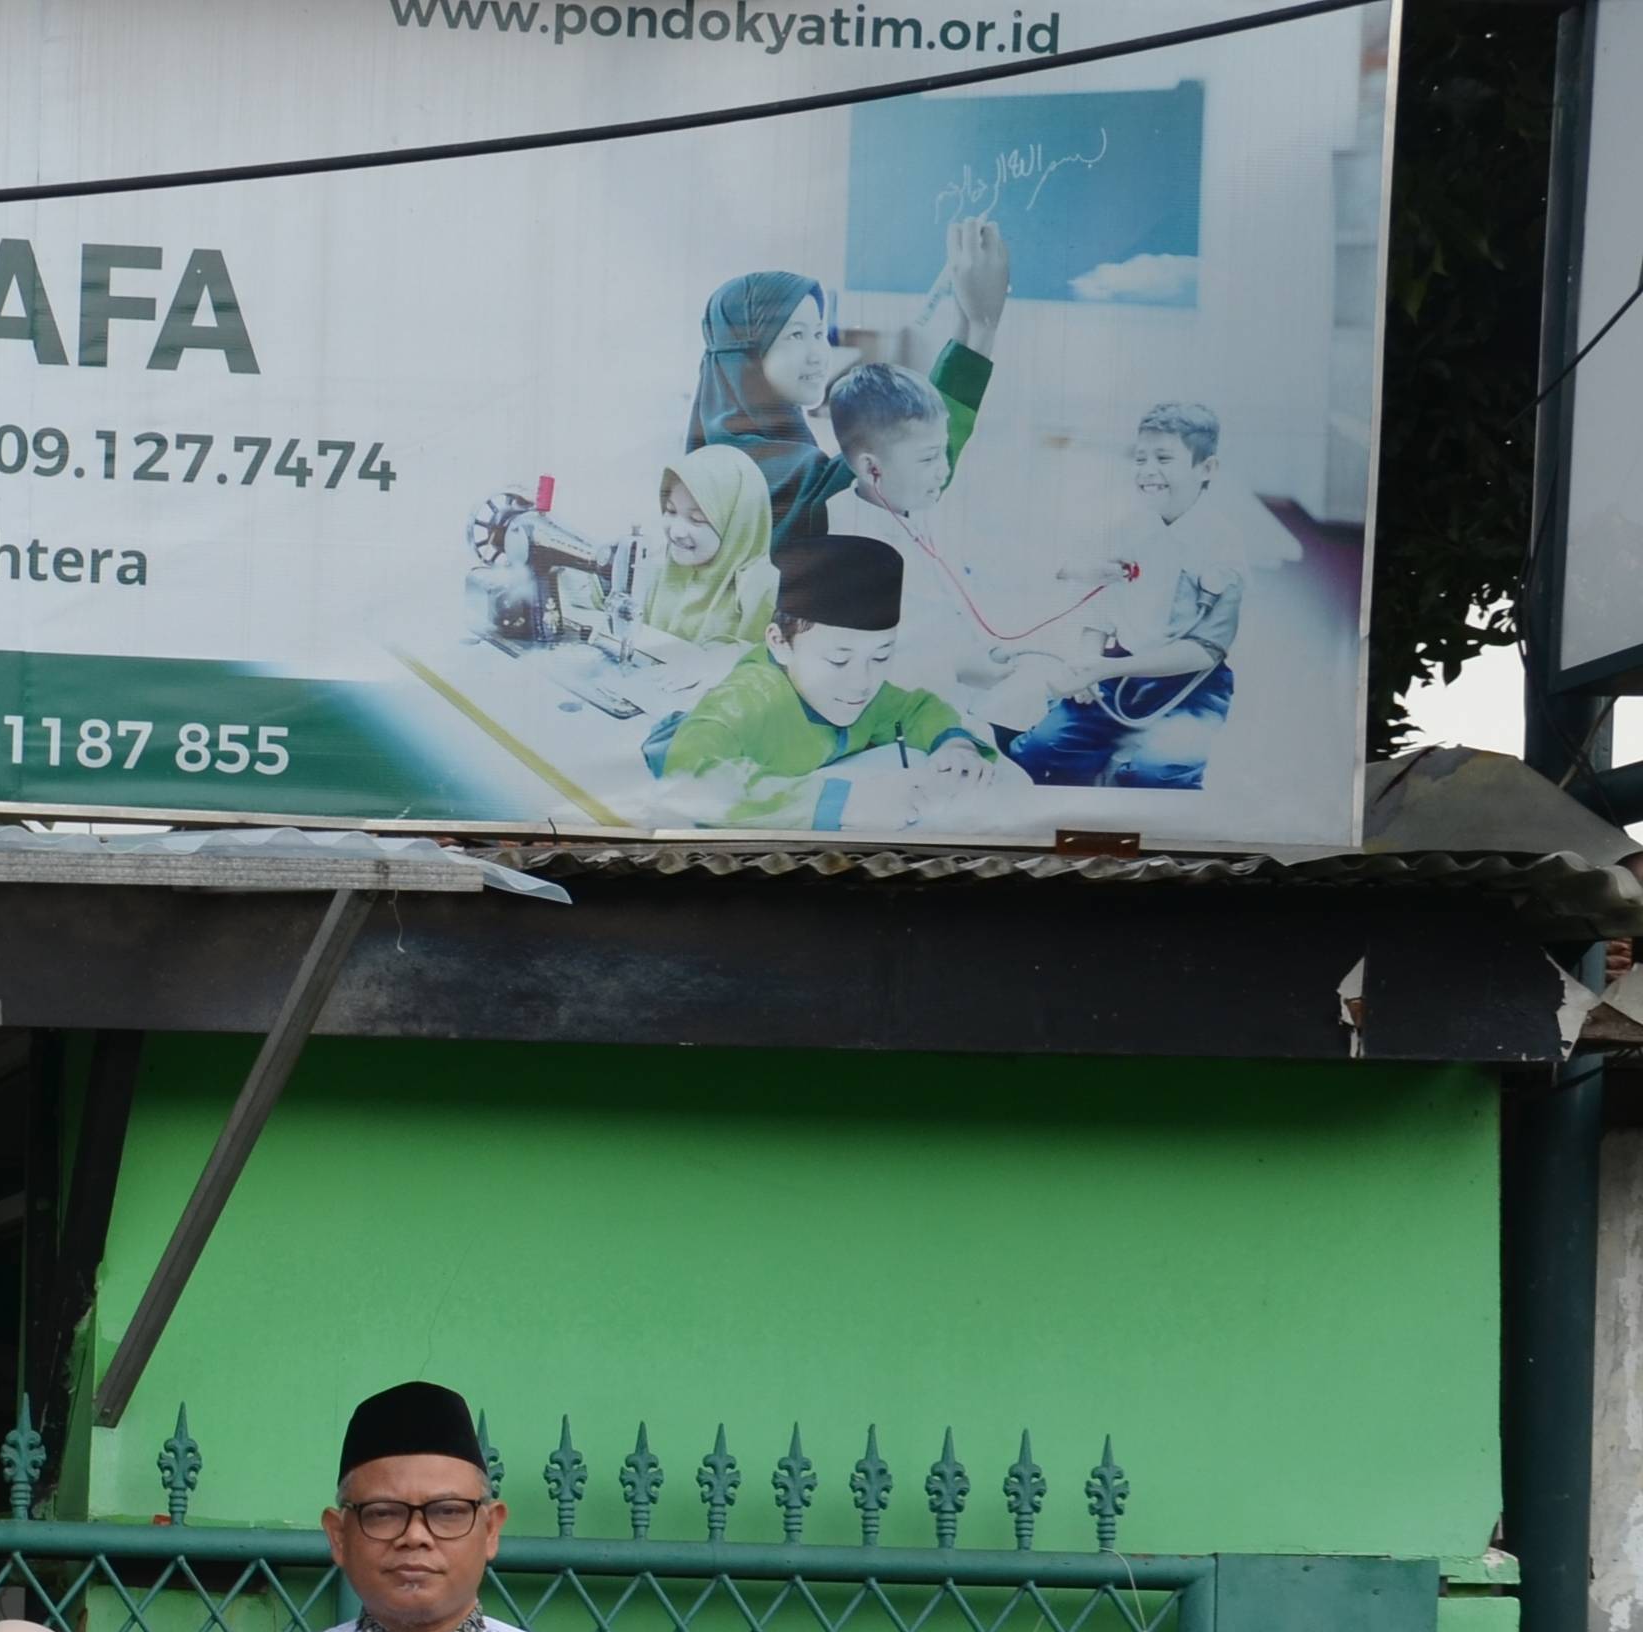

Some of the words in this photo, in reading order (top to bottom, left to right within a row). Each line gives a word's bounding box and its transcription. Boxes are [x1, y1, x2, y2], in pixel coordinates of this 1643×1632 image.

[388, 0, 1060, 55] www.pondokyatim.or.id
[3, 714, 154, 769] 1187
[175, 722, 290, 775] 855
